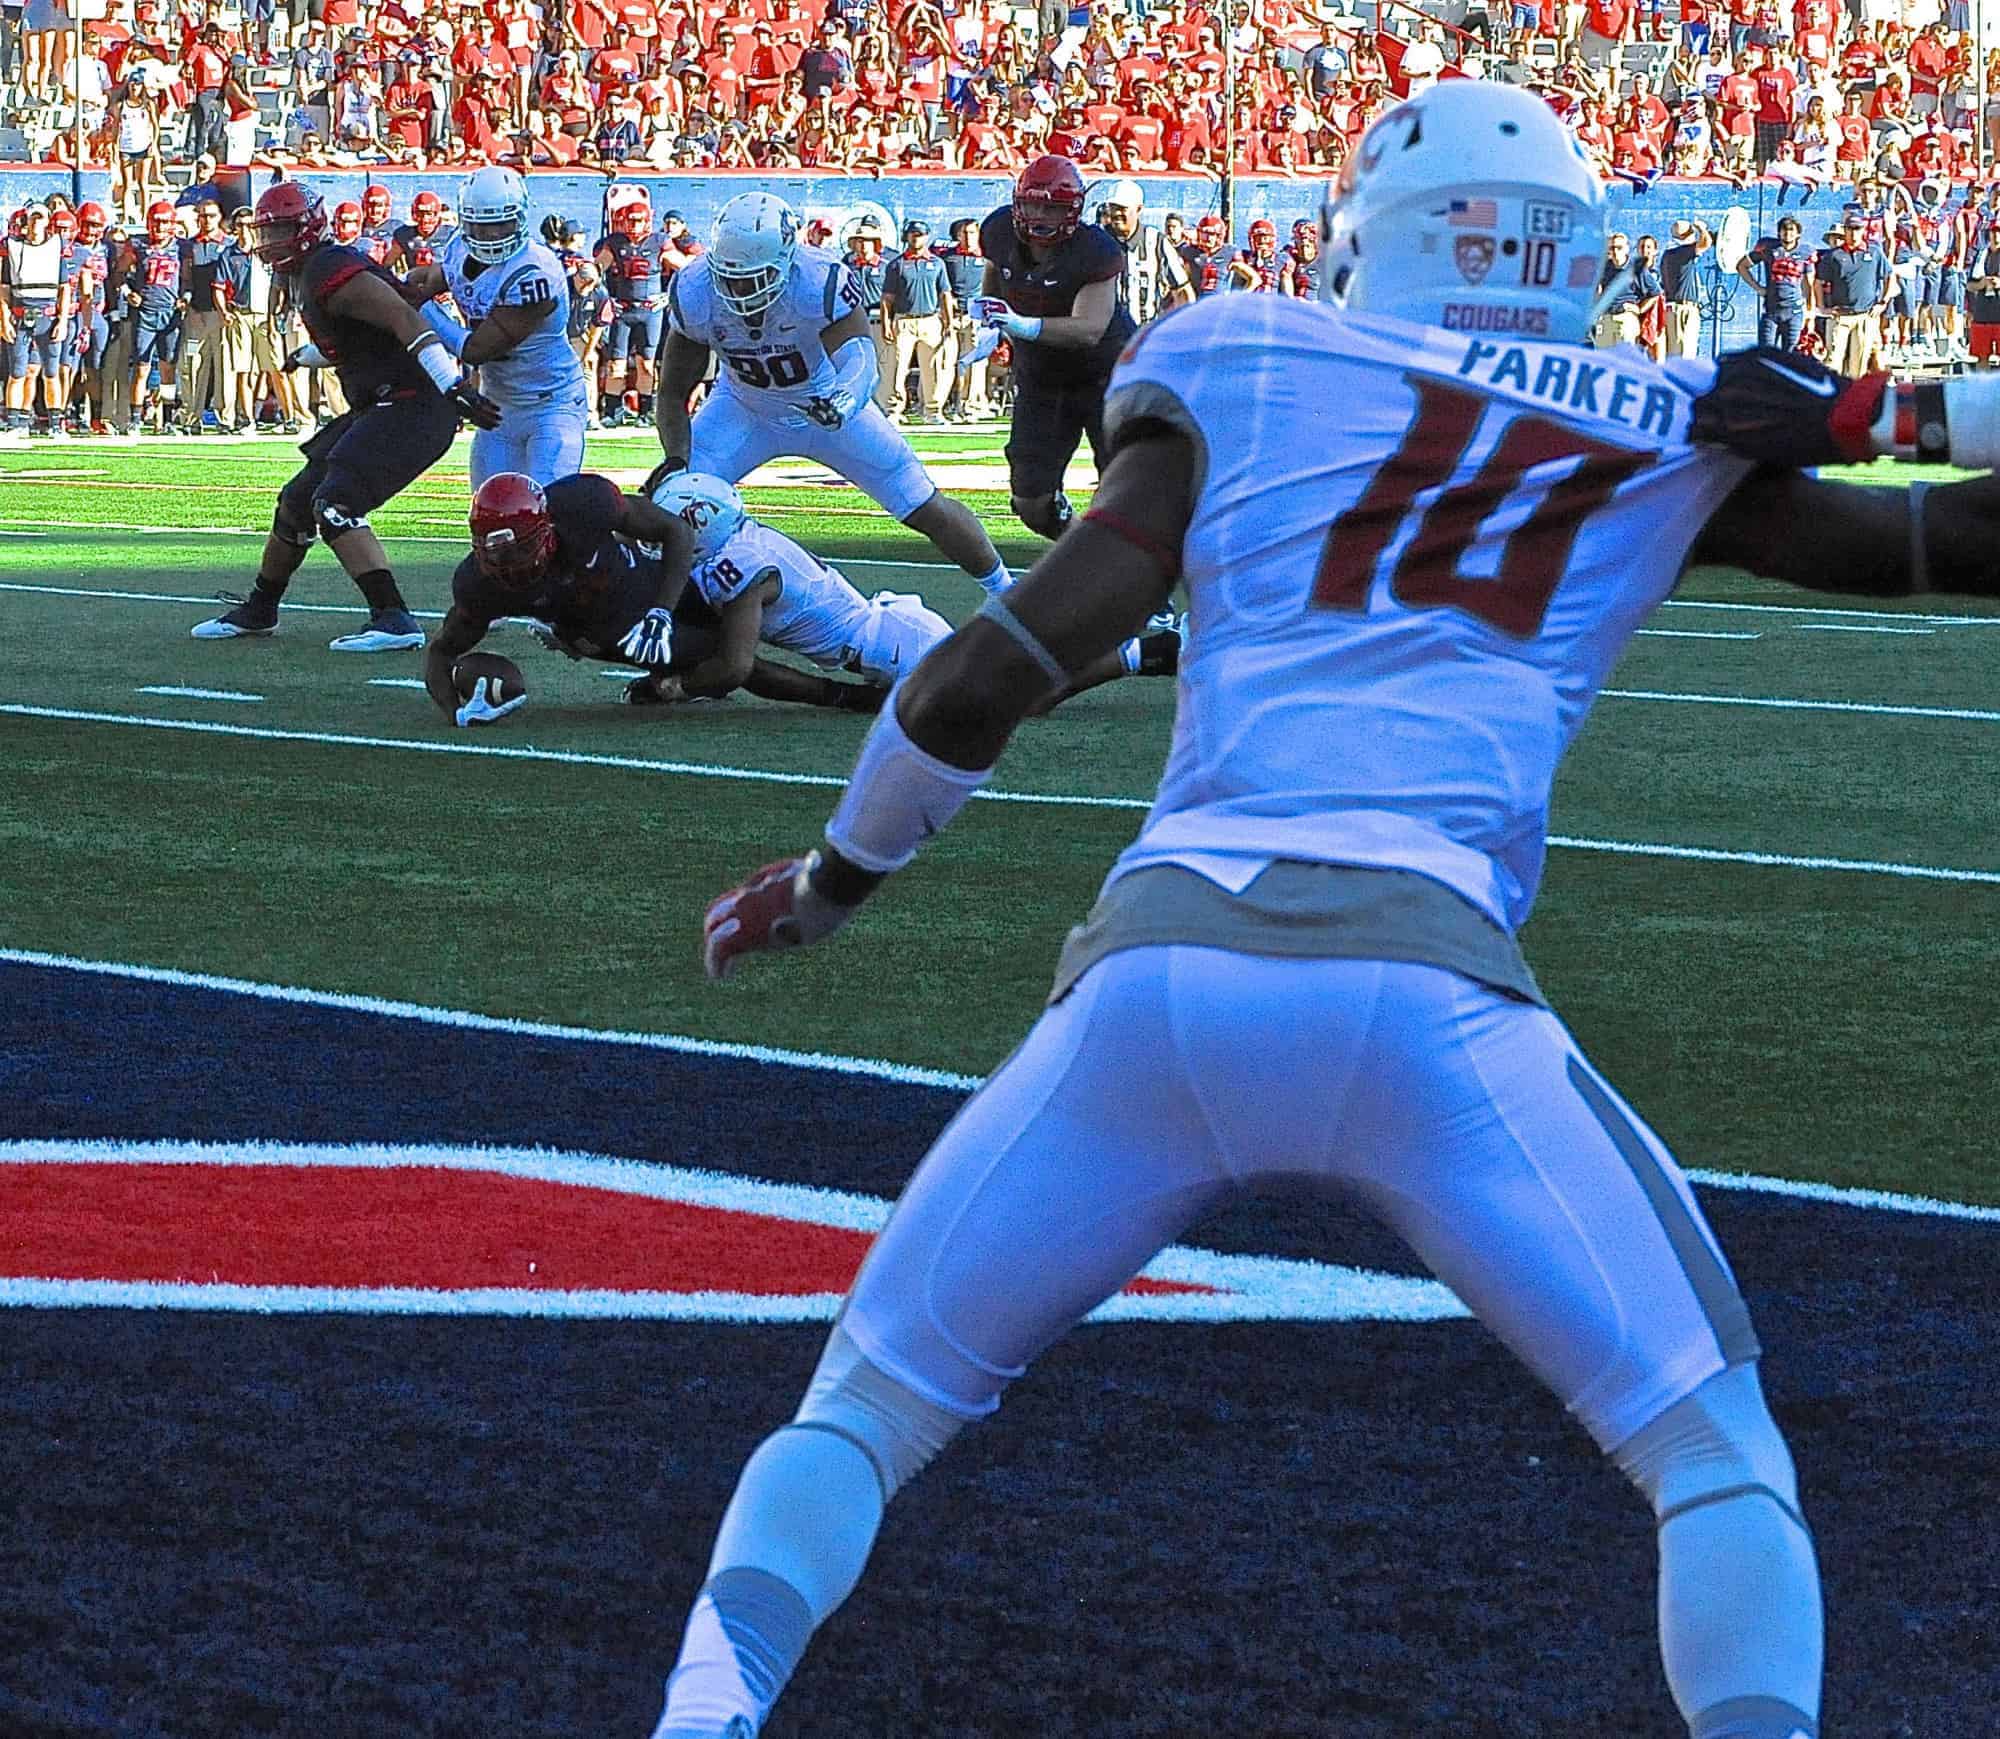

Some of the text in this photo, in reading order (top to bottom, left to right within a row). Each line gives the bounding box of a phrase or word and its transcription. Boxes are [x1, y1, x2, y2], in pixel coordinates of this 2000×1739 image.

[1522, 240, 1556, 284] 10
[520, 278, 552, 305] 50
[1442, 303, 1549, 334] COUGARS
[727, 351, 810, 388] 90
[1459, 340, 1676, 437] PARKER
[1309, 372, 1662, 639] 10
[711, 558, 744, 593] 18
